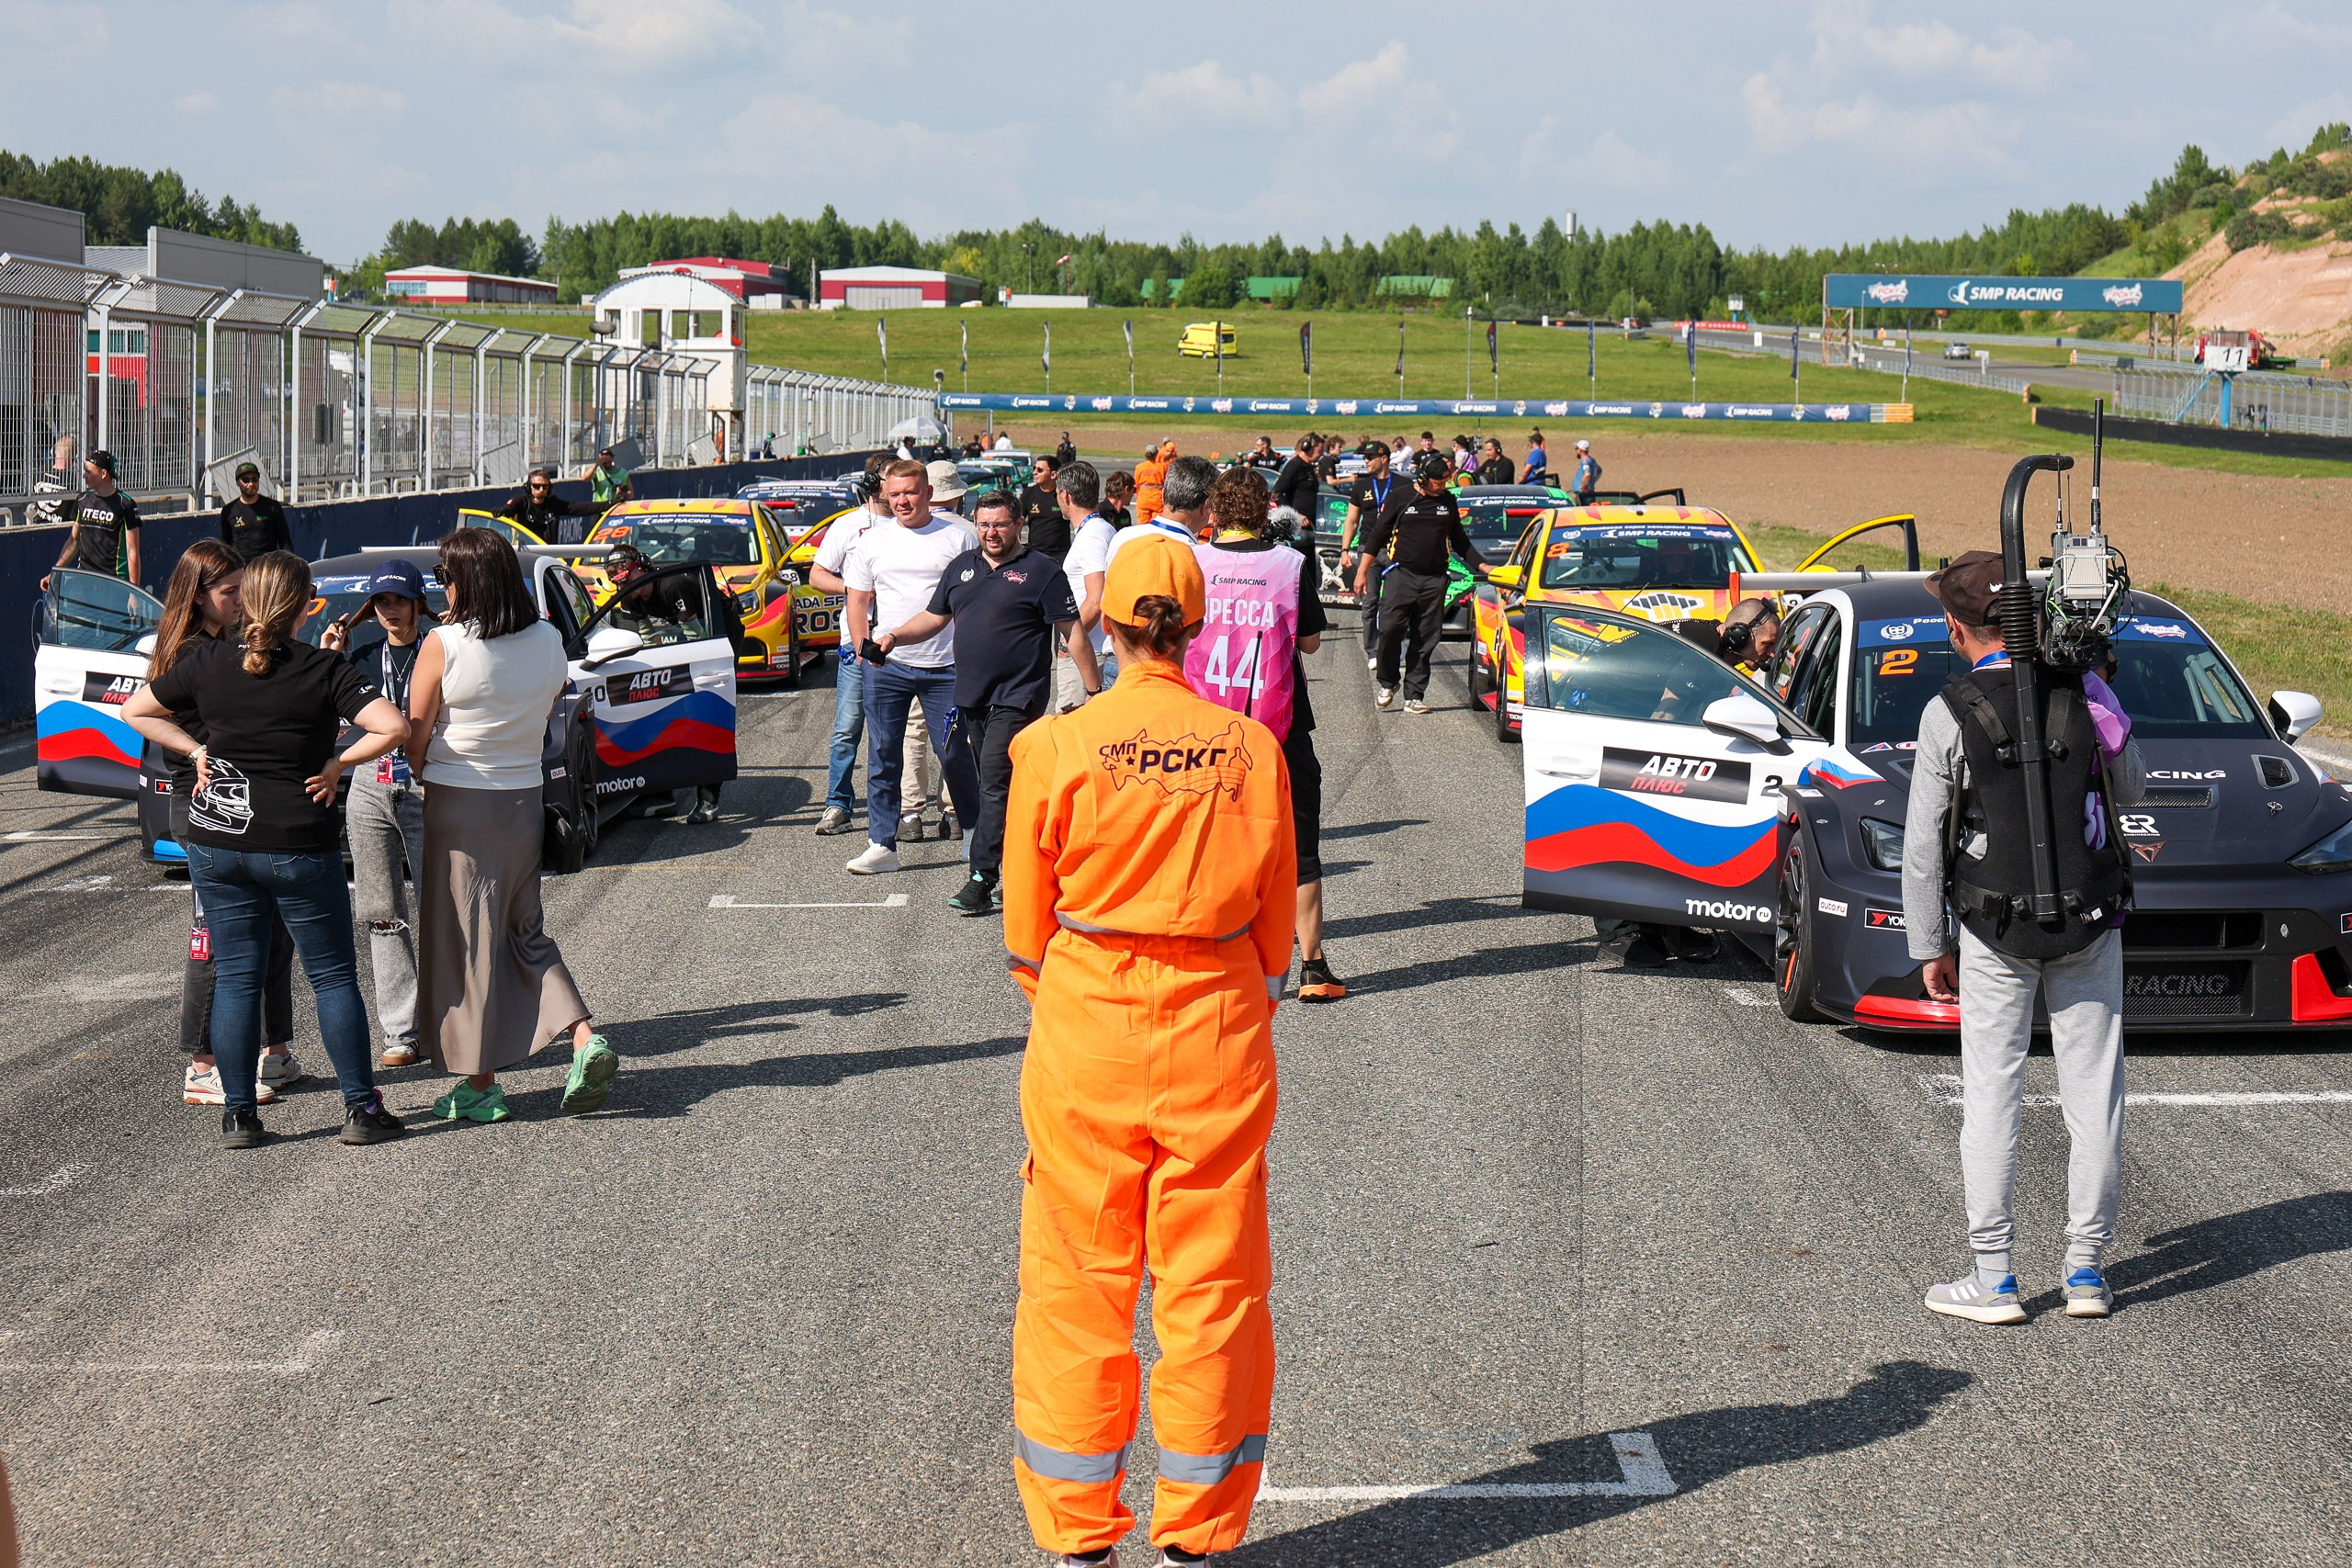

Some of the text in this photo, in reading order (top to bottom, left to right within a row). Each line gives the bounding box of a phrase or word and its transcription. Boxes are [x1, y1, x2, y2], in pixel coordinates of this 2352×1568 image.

[1969, 287, 2064, 300] SMP RACING
[2223, 348, 2243, 364] 11
[1608, 406, 1632, 414] RACING
[1747, 408, 1773, 416] RACING
[82, 508, 114, 522] ITECO
[593, 525, 631, 541] 28
[1547, 542, 1570, 558] 8
[1204, 635, 1264, 700] 44
[1879, 649, 1918, 675] 2
[107, 676, 145, 693] АВТ
[628, 669, 672, 690] АВТО
[101, 692, 130, 704] ПЛЮ
[628, 688, 661, 703] ПЛЮС
[1100, 742, 1136, 756] СМП
[1139, 748, 1227, 774] РСКГ
[1639, 755, 1717, 781] АВТО
[596, 776, 636, 795] motor
[1631, 776, 1688, 795] ПЛЮС
[1761, 775, 1783, 796] 2
[1686, 898, 1756, 919] motor
[1820, 900, 1846, 914] auto.ru
[2125, 975, 2230, 995] RACING
